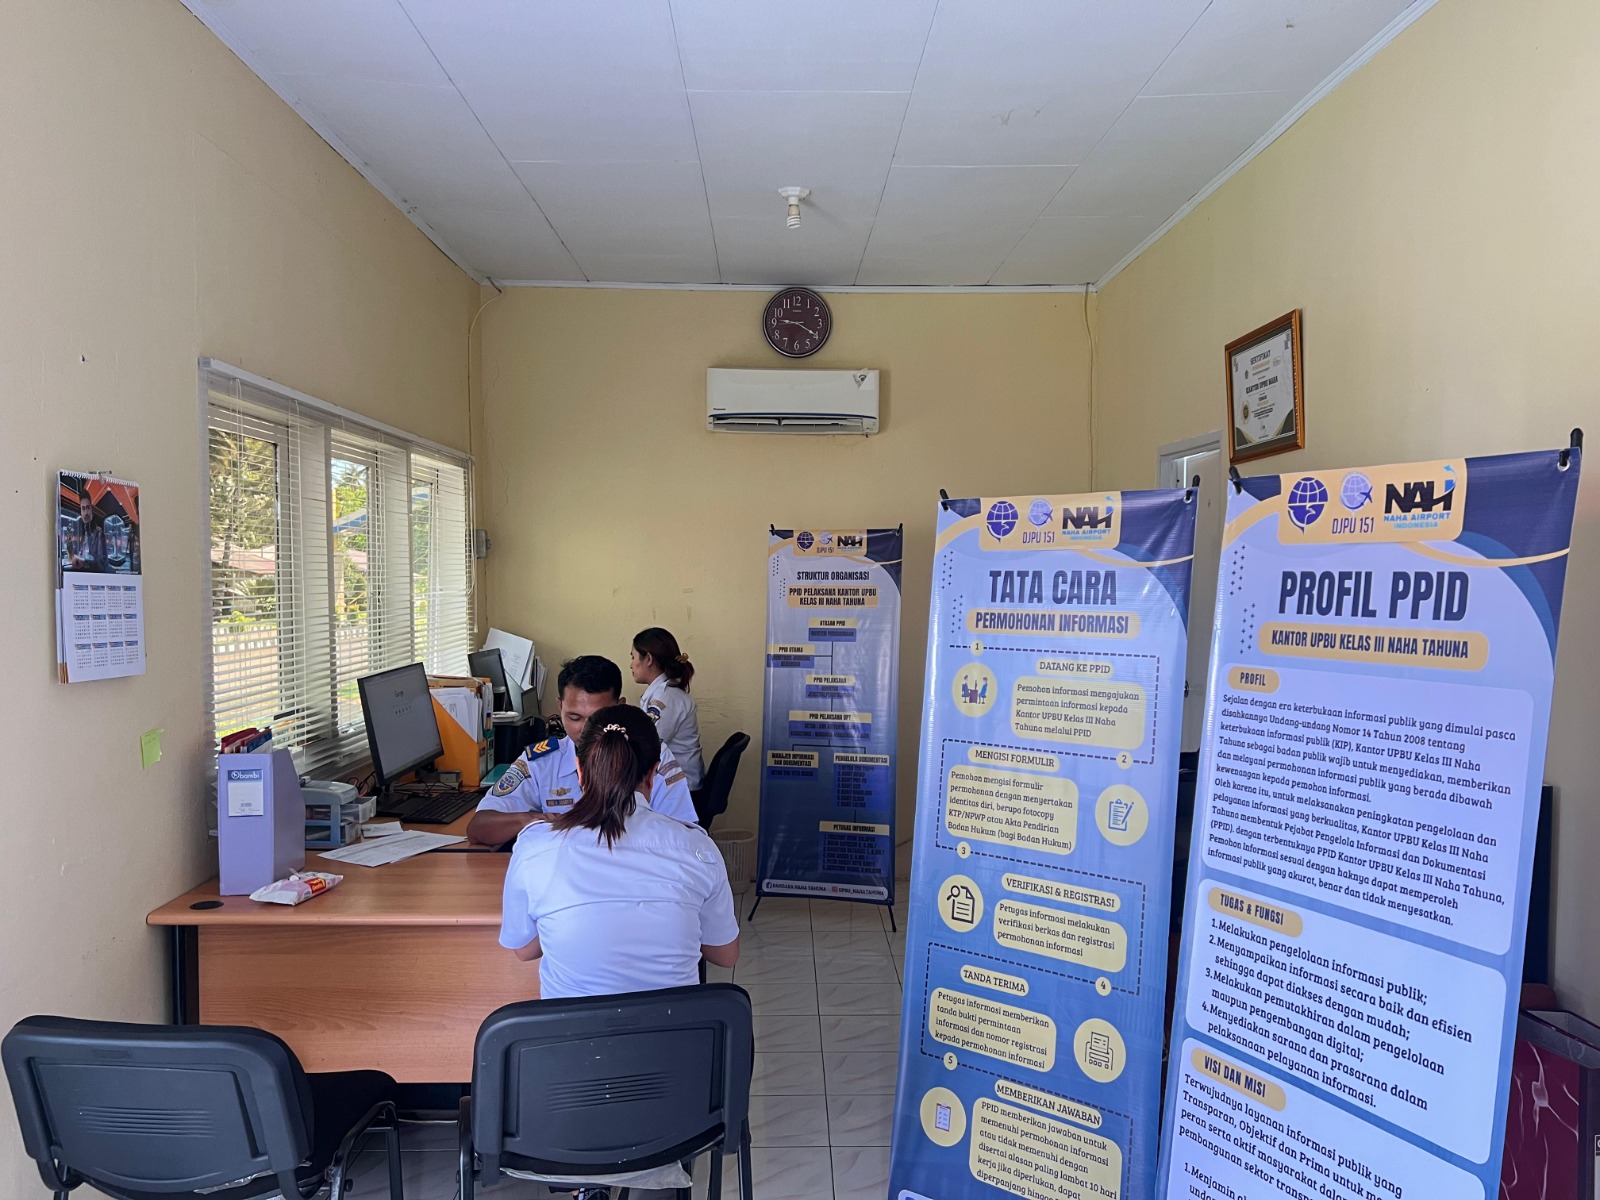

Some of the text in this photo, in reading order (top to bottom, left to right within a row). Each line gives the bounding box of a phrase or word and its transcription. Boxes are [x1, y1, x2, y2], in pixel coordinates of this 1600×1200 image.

[784, 299, 790, 308] 11
[793, 296, 801, 306] 12
[807, 299, 810, 308] 1
[775, 308, 783, 317] 10
[814, 307, 819, 316] 2
[772, 318, 777, 328] 9
[817, 319, 822, 329] 3
[775, 330, 779, 340] 8
[783, 338, 788, 347] 7
[805, 339, 810, 348] 5
[794, 340, 799, 350] 6
[1332, 517, 1374, 534] DJPU 151
[1384, 512, 1450, 522] NAHA AIRPORT
[1022, 531, 1054, 543] DJPU 151
[797, 572, 870, 580] STRUKTUR ORGANISASI
[803, 588, 836, 596] PELAKSANA
[837, 588, 859, 596] KANTOR
[989, 570, 1117, 606] TATA CARA
[1278, 571, 1469, 622] PROFIL PPID
[800, 597, 817, 605] KELAS
[975, 612, 1129, 634] PERMOHONAN INFORMASI
[1271, 629, 1468, 658] KANTOR UPBU KELAS III NAHA TAHUNA
[1039, 661, 1110, 673] DATANG KE PPID
[1240, 673, 1266, 686] PROFIL
[1016, 683, 1139, 701] Pemohon informasi mengajukan
[1016, 697, 1128, 714] permintaan informasi kepada
[1222, 694, 1515, 740] Sejalan dengan era keterbukaan informasi publik yang dimulai pasca
[975, 749, 1054, 767] MENGISI FORMULIR
[961, 847, 966, 855] 3
[1006, 877, 1114, 908] VERIFIKASI & REGISTRASI
[1220, 893, 1283, 925] TUGAS & FUNGSI
[1269, 939, 1329, 968] pengelolaan
[1331, 959, 1384, 988] informasi
[1386, 981, 1427, 1005] publik;
[963, 969, 1025, 993] TANDA TERIMA
[1101, 981, 1106, 990] 4
[1214, 955, 1410, 1041] sehingga dapat diakses dengan mudah;
[1288, 965, 1337, 991] informasi
[1340, 984, 1375, 1005] secara
[1378, 995, 1404, 1016] baik
[1406, 1007, 1428, 1026] dan
[1431, 1018, 1471, 1042] efisien
[1211, 988, 1364, 1062] maupun pengembangan digital;
[1264, 992, 1334, 1028] pemutakhiran
[1336, 1020, 1370, 1044] dalam
[1373, 1037, 1444, 1075] pengelolaan
[1207, 1022, 1376, 1107] pelaksanaan pelayanan informasi.
[1272, 1032, 1306, 1055] sarana
[1308, 1047, 1328, 1065] dan
[1330, 1058, 1387, 1092] prasarana
[1390, 1084, 1427, 1110] dalam
[1204, 1055, 1265, 1097] VISI DAN MISI
[996, 1084, 1100, 1125] MEMBERIKAN JAWABAN
[1183, 1090, 1364, 1197] Transparan, Objektif dan Prima untuk
[1185, 1073, 1402, 1198] Terwujudnya layanan informasi publik yang
